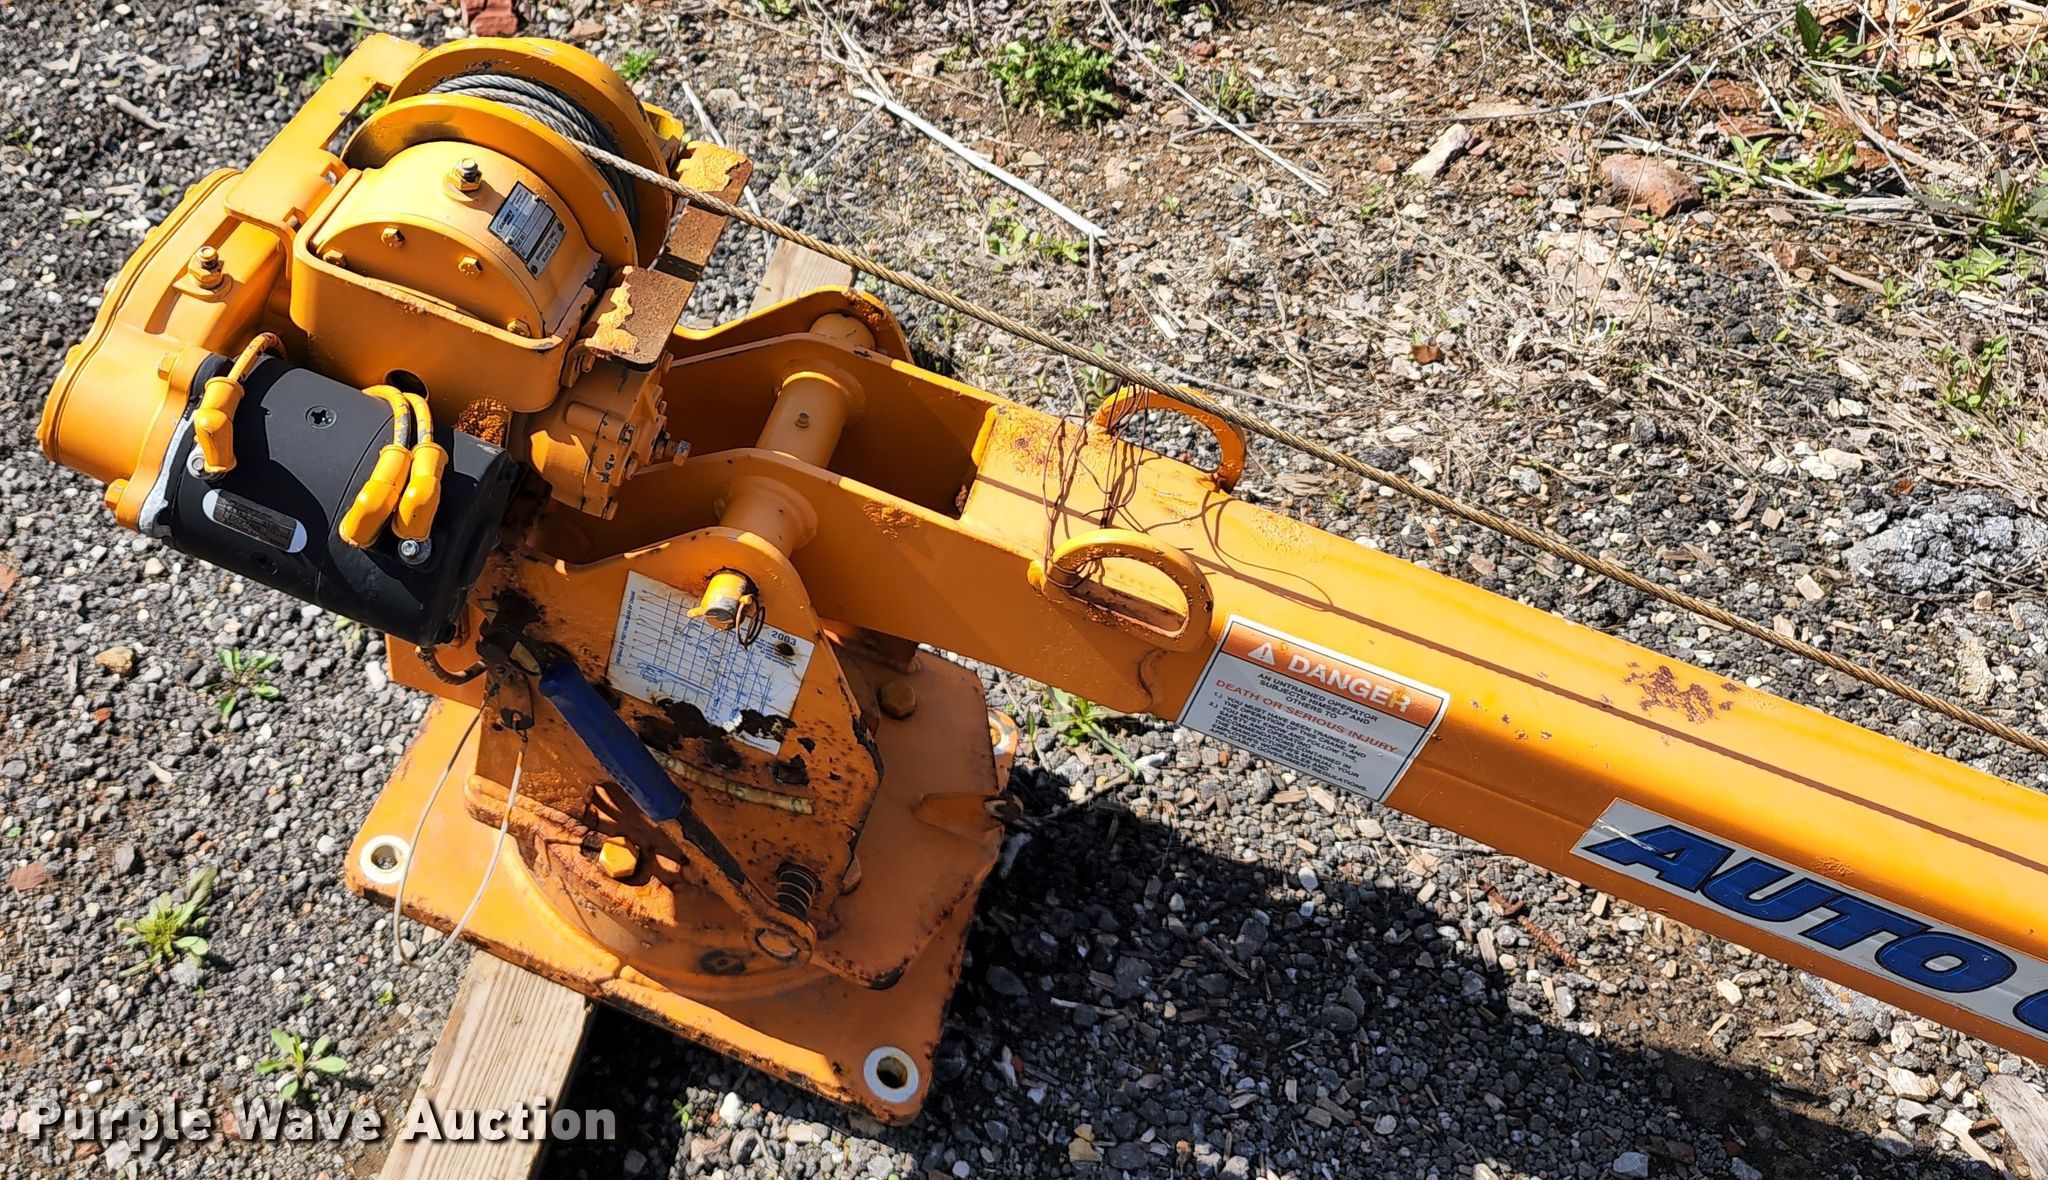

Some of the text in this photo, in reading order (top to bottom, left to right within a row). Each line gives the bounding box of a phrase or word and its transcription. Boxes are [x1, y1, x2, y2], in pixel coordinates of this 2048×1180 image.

[770, 629, 798, 646] 2003
[1257, 672, 1378, 721] AN UNTRAINED OPERATOR
[1258, 679, 1370, 725] SUBJECTS HIMSELF AND
[1284, 695, 1338, 719] OTHERS TO
[1285, 652, 1414, 713] DANGER
[1215, 679, 1398, 753] DEATH OR SERIOUS INJURY
[1215, 714, 1295, 748] RECOMMENDATIONS
[1295, 744, 1341, 765] CONTAINED
[1218, 710, 1312, 749] SAFETY AND OPERATING
[1221, 705, 1238, 715] YOU
[1238, 712, 1262, 724] MUST
[1262, 721, 1288, 734] KNOW
[1287, 730, 1306, 741] AND
[1306, 738, 1340, 754] FOLLOW
[1223, 700, 1239, 709] THE
[1239, 706, 1285, 727] OPERATION
[1298, 729, 1317, 739] THIS
[1348, 748, 1367, 758] AND
[1225, 696, 1243, 705] YOU
[1243, 702, 1266, 714] MUST
[1266, 711, 1289, 723] HAVE
[1289, 720, 1311, 731] BEEN
[1312, 728, 1347, 745] TRAINED
[1213, 718, 1229, 728] THE
[1336, 765, 1360, 778] YOUR
[1583, 825, 2017, 993] AUTO
